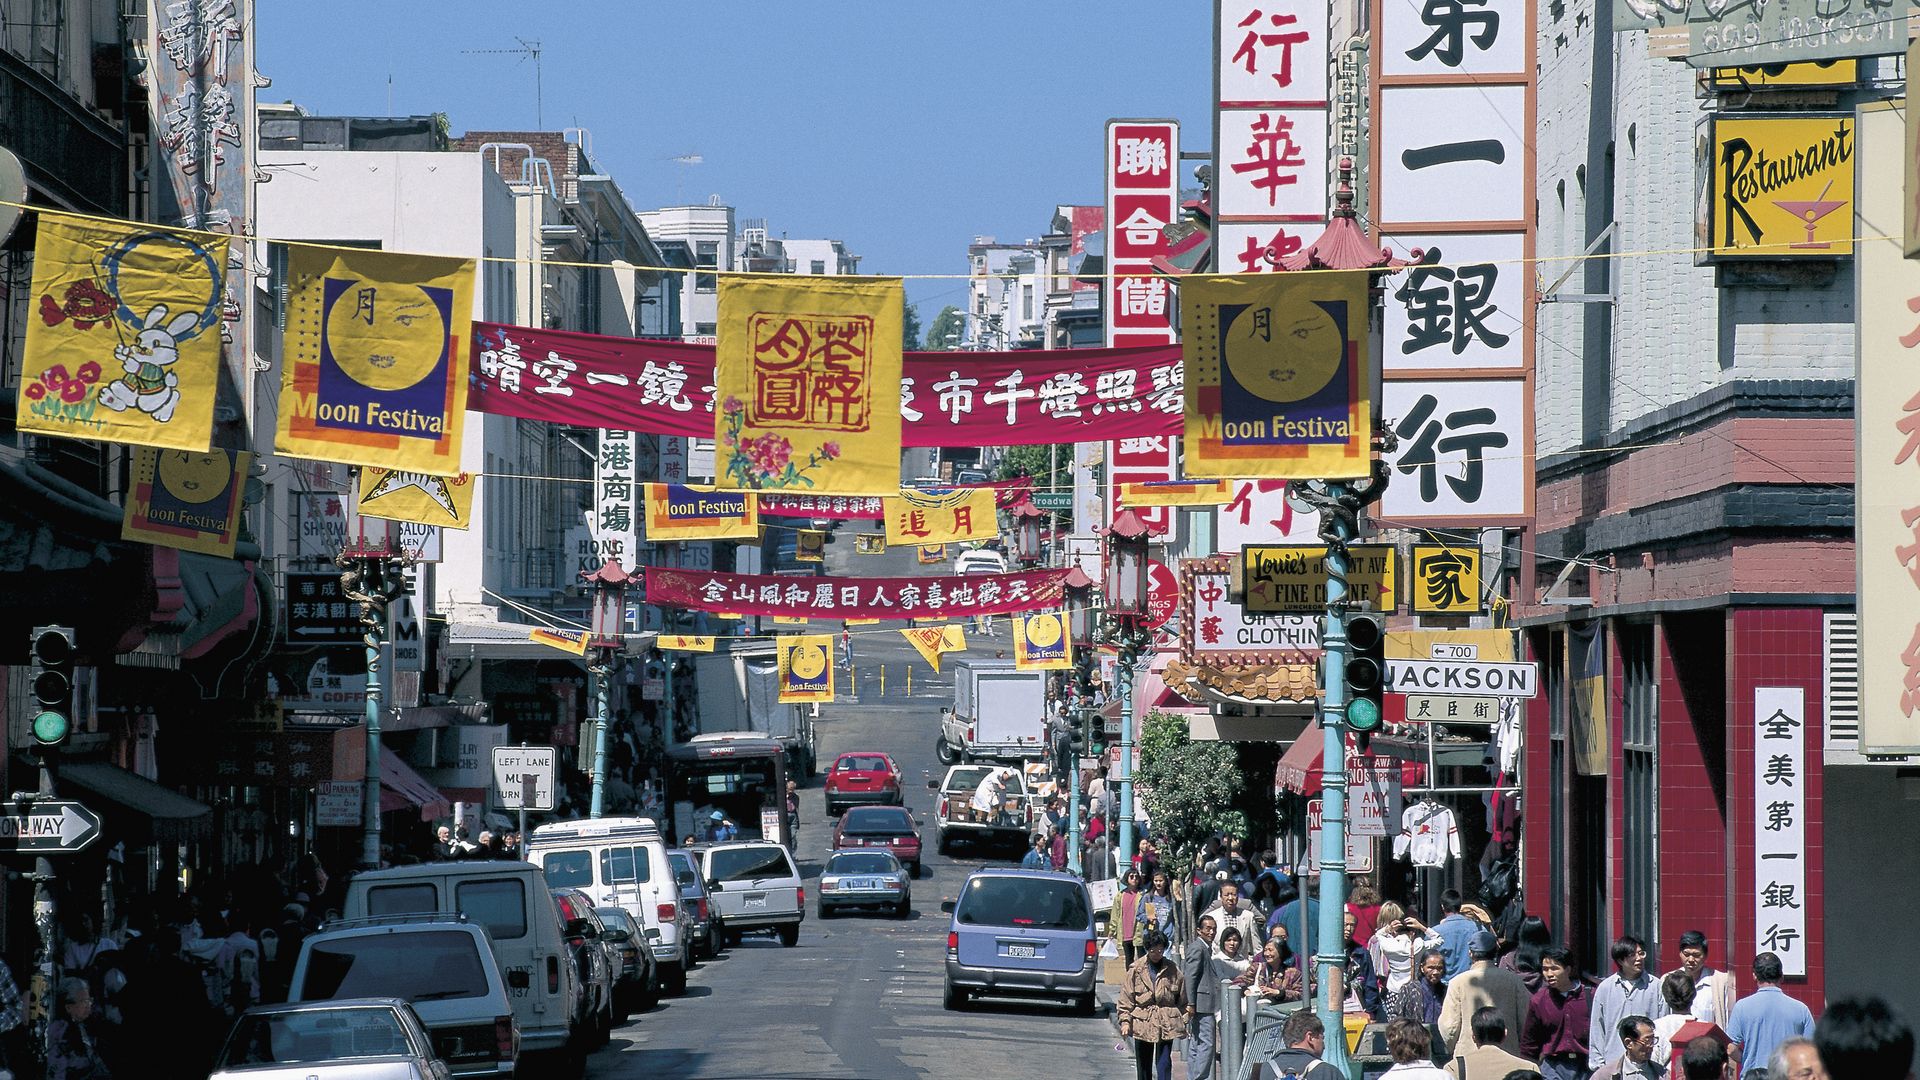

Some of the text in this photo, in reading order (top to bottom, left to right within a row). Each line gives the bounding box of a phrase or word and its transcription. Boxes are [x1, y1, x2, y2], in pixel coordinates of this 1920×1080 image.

[1770, 11, 1894, 50] JACKSON
[1721, 119, 1852, 248] Restaurant
[352, 287, 377, 326] 月
[1249, 306, 1273, 343] 月
[293, 391, 452, 434] Moon Festival
[1200, 413, 1359, 440] Moon Festival
[654, 500, 750, 516] Moon Festival
[1032, 497, 1072, 506] Broadwa
[135, 499, 231, 531] Moon Festival
[900, 505, 974, 538] 追月
[399, 522, 435, 536] SALON
[1253, 549, 1307, 582] Louie's
[1367, 557, 1391, 574] AVE.
[1419, 551, 1472, 610] 家
[1275, 584, 1309, 602] FINE
[1237, 628, 1320, 644] CLOTHIN
[1449, 646, 1472, 658] 700
[1384, 664, 1526, 691] JACKSON
[499, 758, 550, 766] LEFT LANE
[505, 774, 540, 784] MUT
[1349, 768, 1400, 784] NO STOPPING
[498, 790, 520, 799] TURN
[1363, 792, 1389, 803] ANY
[1361, 806, 1390, 818] TIME
[33, 818, 65, 835] WAY
[1758, 708, 1802, 952] 全美第一銀行
